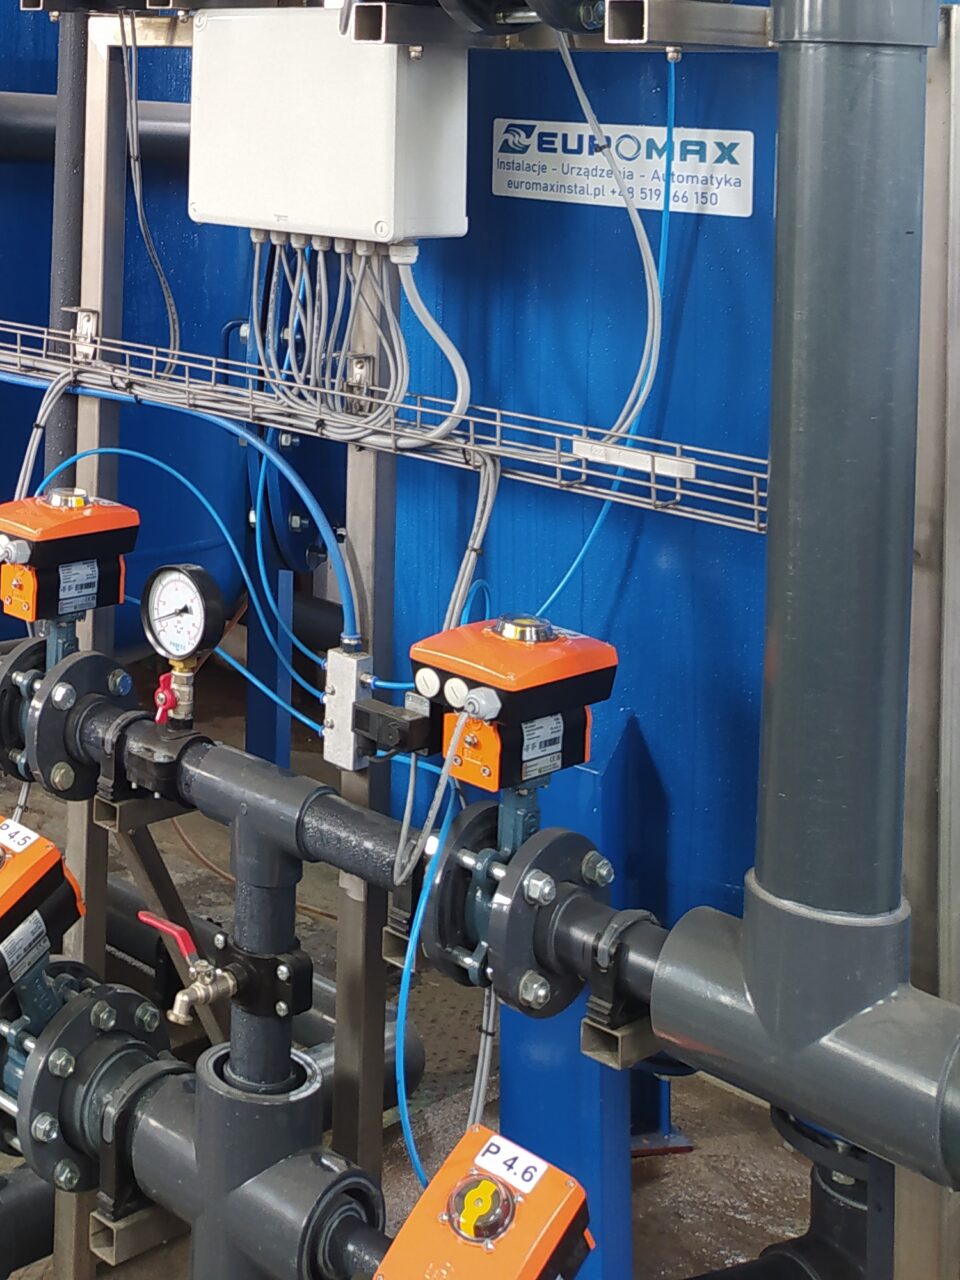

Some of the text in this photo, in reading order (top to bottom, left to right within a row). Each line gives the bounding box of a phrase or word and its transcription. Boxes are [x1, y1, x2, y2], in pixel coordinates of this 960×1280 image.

[496, 157, 548, 177] Instalacje
[561, 162, 634, 181] Urządzeia
[507, 178, 605, 199] euromaxinstal.pl
[640, 187, 662, 202] 519
[694, 191, 719, 206] 150
[7, 830, 31, 846] 4.5
[481, 1142, 538, 1183] P 4.6
